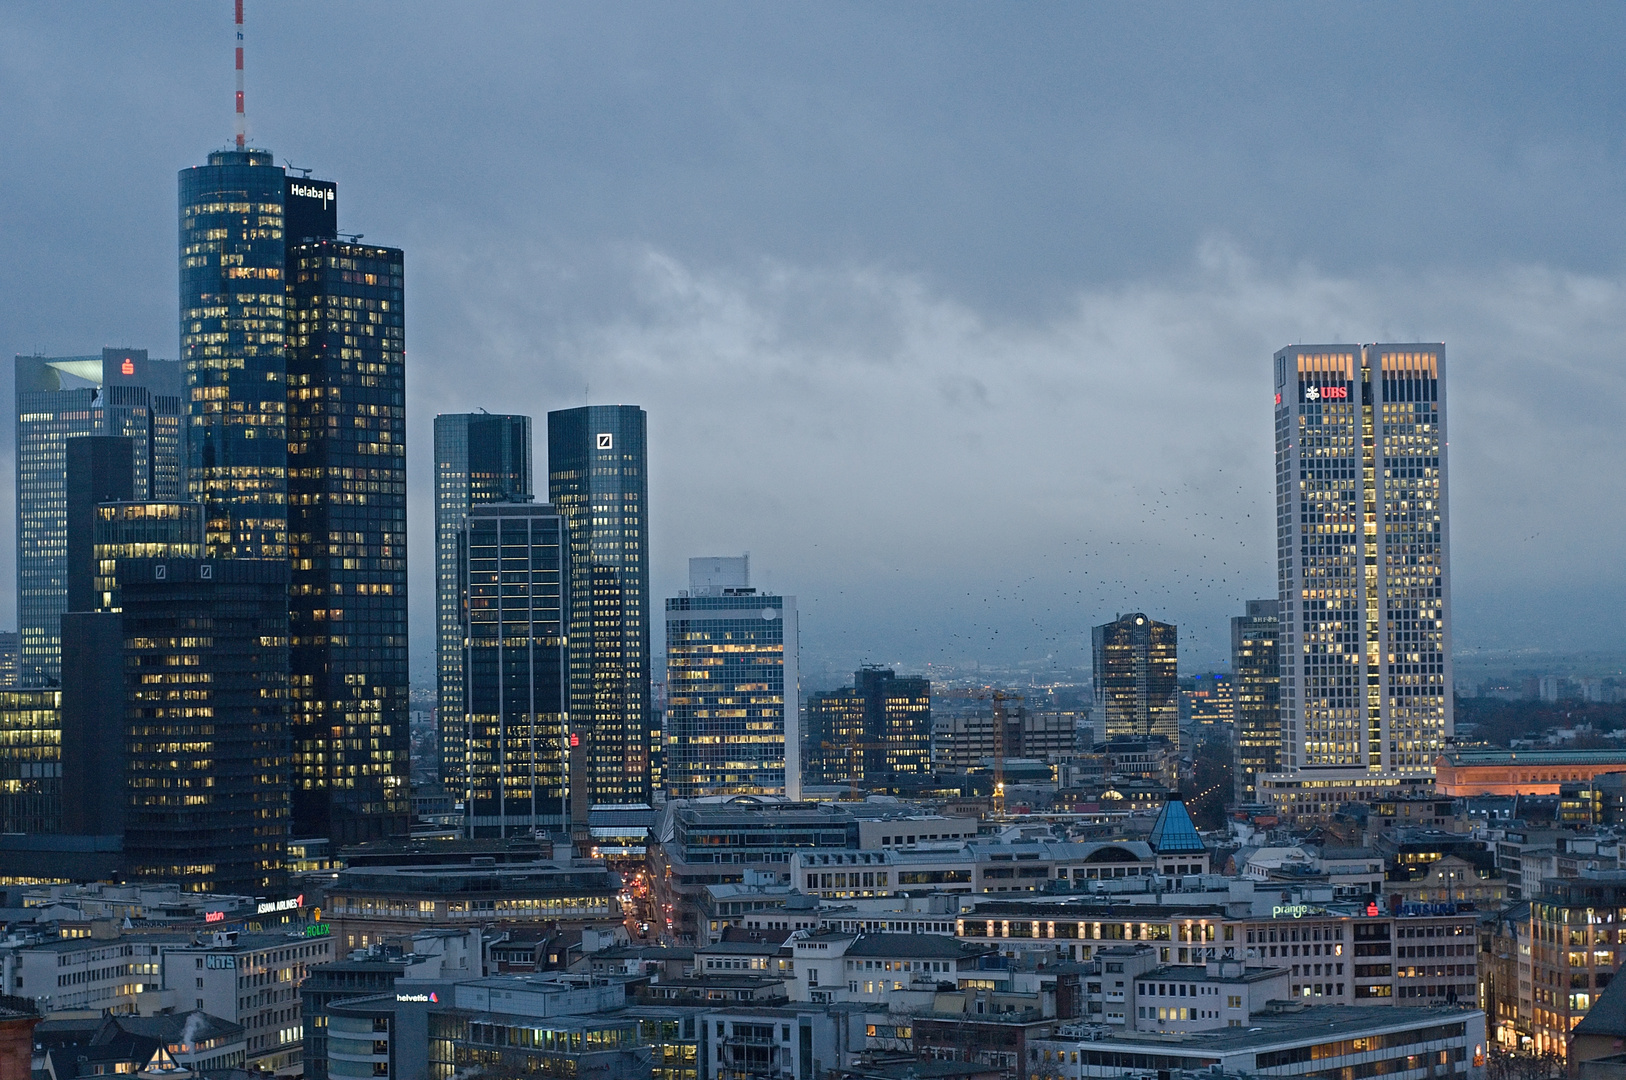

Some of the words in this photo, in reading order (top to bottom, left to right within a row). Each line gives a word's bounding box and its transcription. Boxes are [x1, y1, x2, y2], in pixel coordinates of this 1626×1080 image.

[291, 183, 323, 198] Helaba
[1321, 387, 1347, 398] UBS
[257, 902, 276, 914] ASIANA
[276, 898, 297, 911] AIRLINES
[1395, 903, 1455, 914] SAMSUNG
[205, 910, 224, 922] bodum
[307, 923, 330, 936] ROLEX
